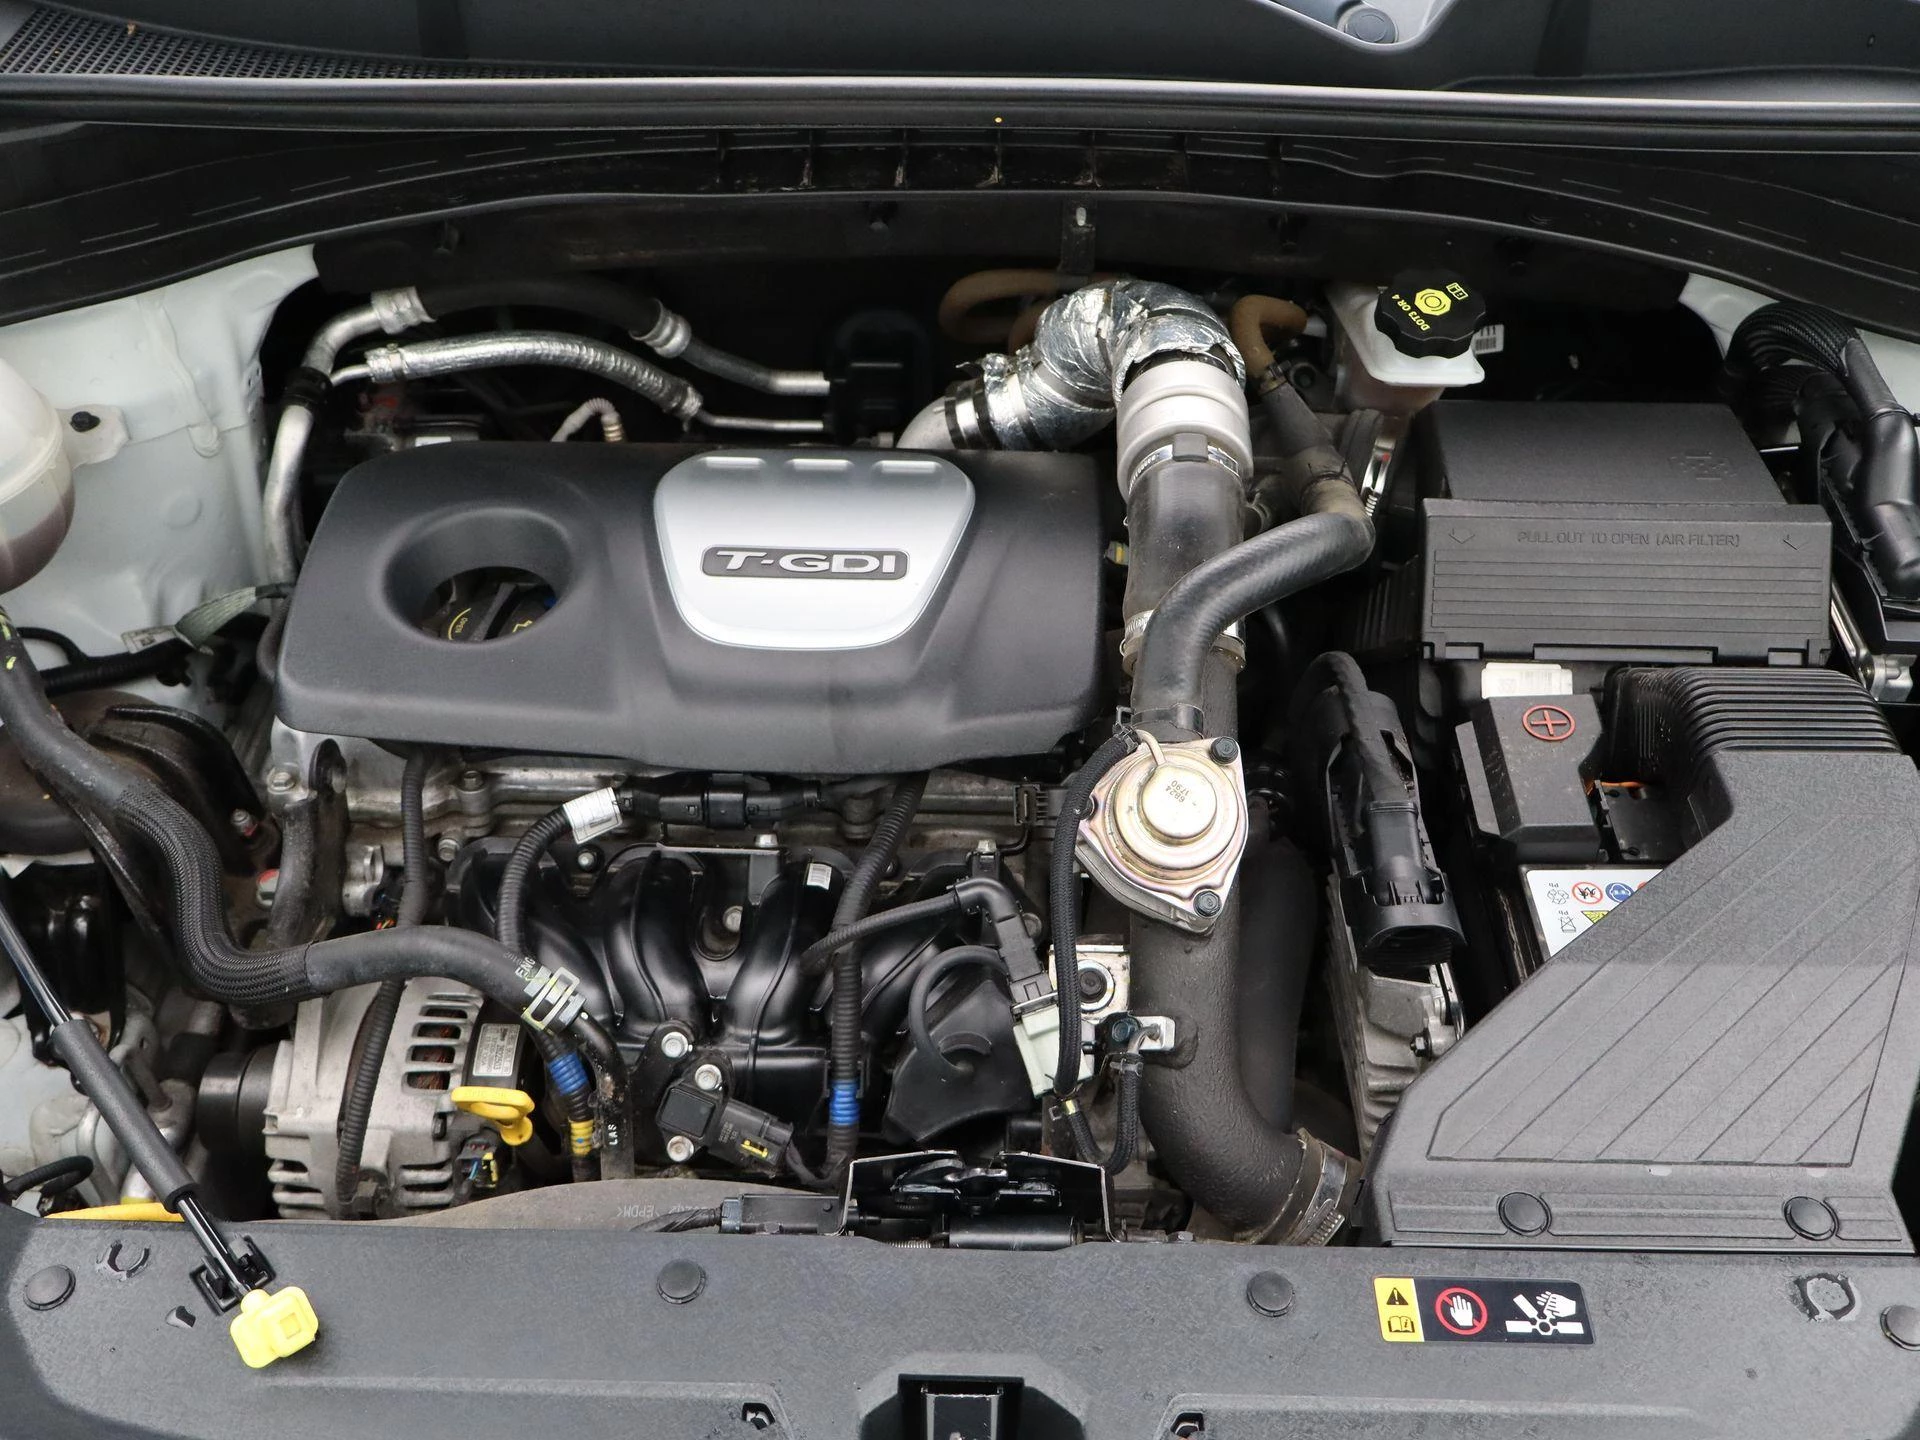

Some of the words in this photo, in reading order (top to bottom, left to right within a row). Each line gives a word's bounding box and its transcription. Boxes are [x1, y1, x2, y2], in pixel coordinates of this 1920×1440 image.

[1397, 299, 1411, 311] OR
[1408, 310, 1431, 331] DOT3
[1517, 531, 1553, 544] PULL
[1556, 531, 1585, 544] OUT
[1590, 532, 1607, 544] TO
[1611, 532, 1649, 546] OPEN
[716, 550, 896, 574] T-GDI
[515, 956, 536, 978] ENG
